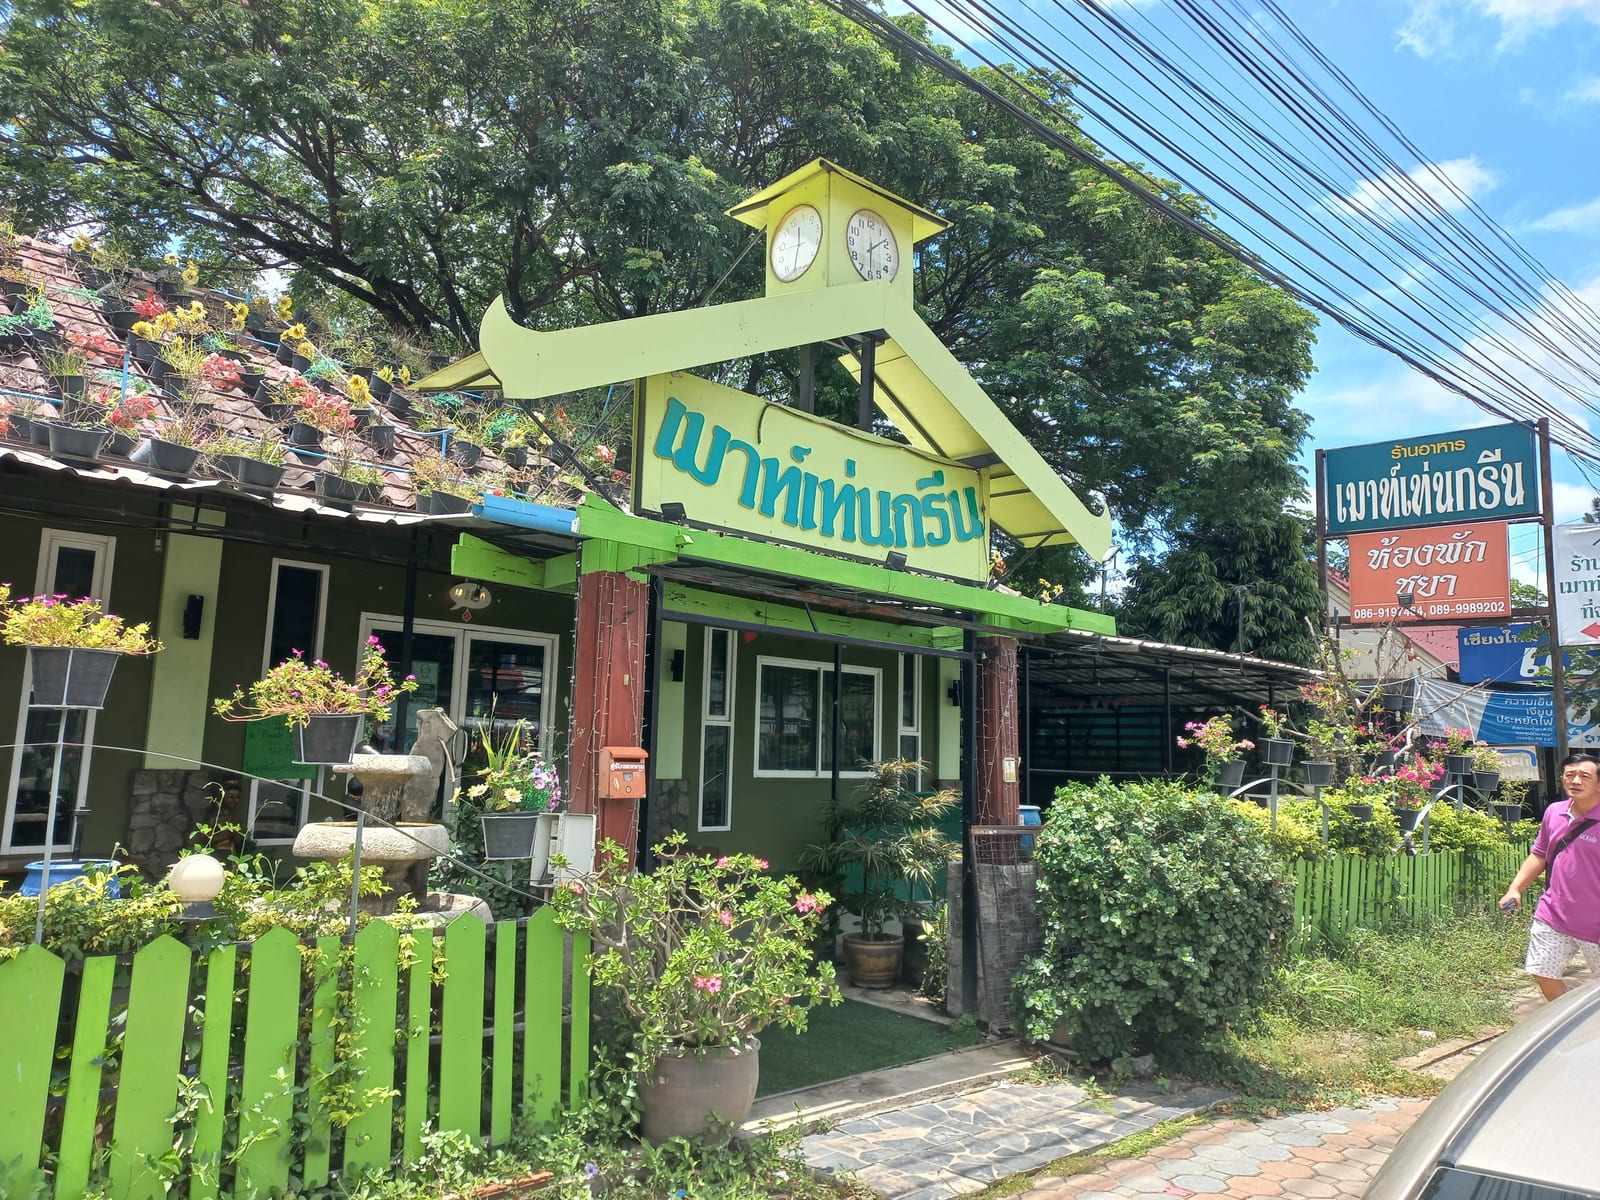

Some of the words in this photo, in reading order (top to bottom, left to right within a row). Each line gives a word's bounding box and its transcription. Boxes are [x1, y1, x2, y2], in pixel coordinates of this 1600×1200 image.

[859, 219, 864, 229] 11
[867, 219, 875, 230] 12
[851, 225, 859, 236] 10
[849, 236, 855, 246] 9
[852, 251, 858, 260] 8
[886, 253, 892, 262] 3
[858, 263, 864, 271] 7
[883, 265, 889, 274] 4
[867, 271, 873, 280] 6
[876, 270, 882, 280] 5
[1391, 439, 1466, 460] ร้านอาหาร
[653, 397, 984, 548] เมาท์เท่นกรีน
[1336, 448, 1525, 523] เมาท์เท่นกรีน
[1367, 530, 1488, 570] ห้องพัก
[1395, 574, 1458, 598] ชยา
[1429, 601, 1505, 616] 089-9989202
[1505, 697, 1553, 707] ความเย็น
[1496, 714, 1554, 726] ประหยัดไฟ
